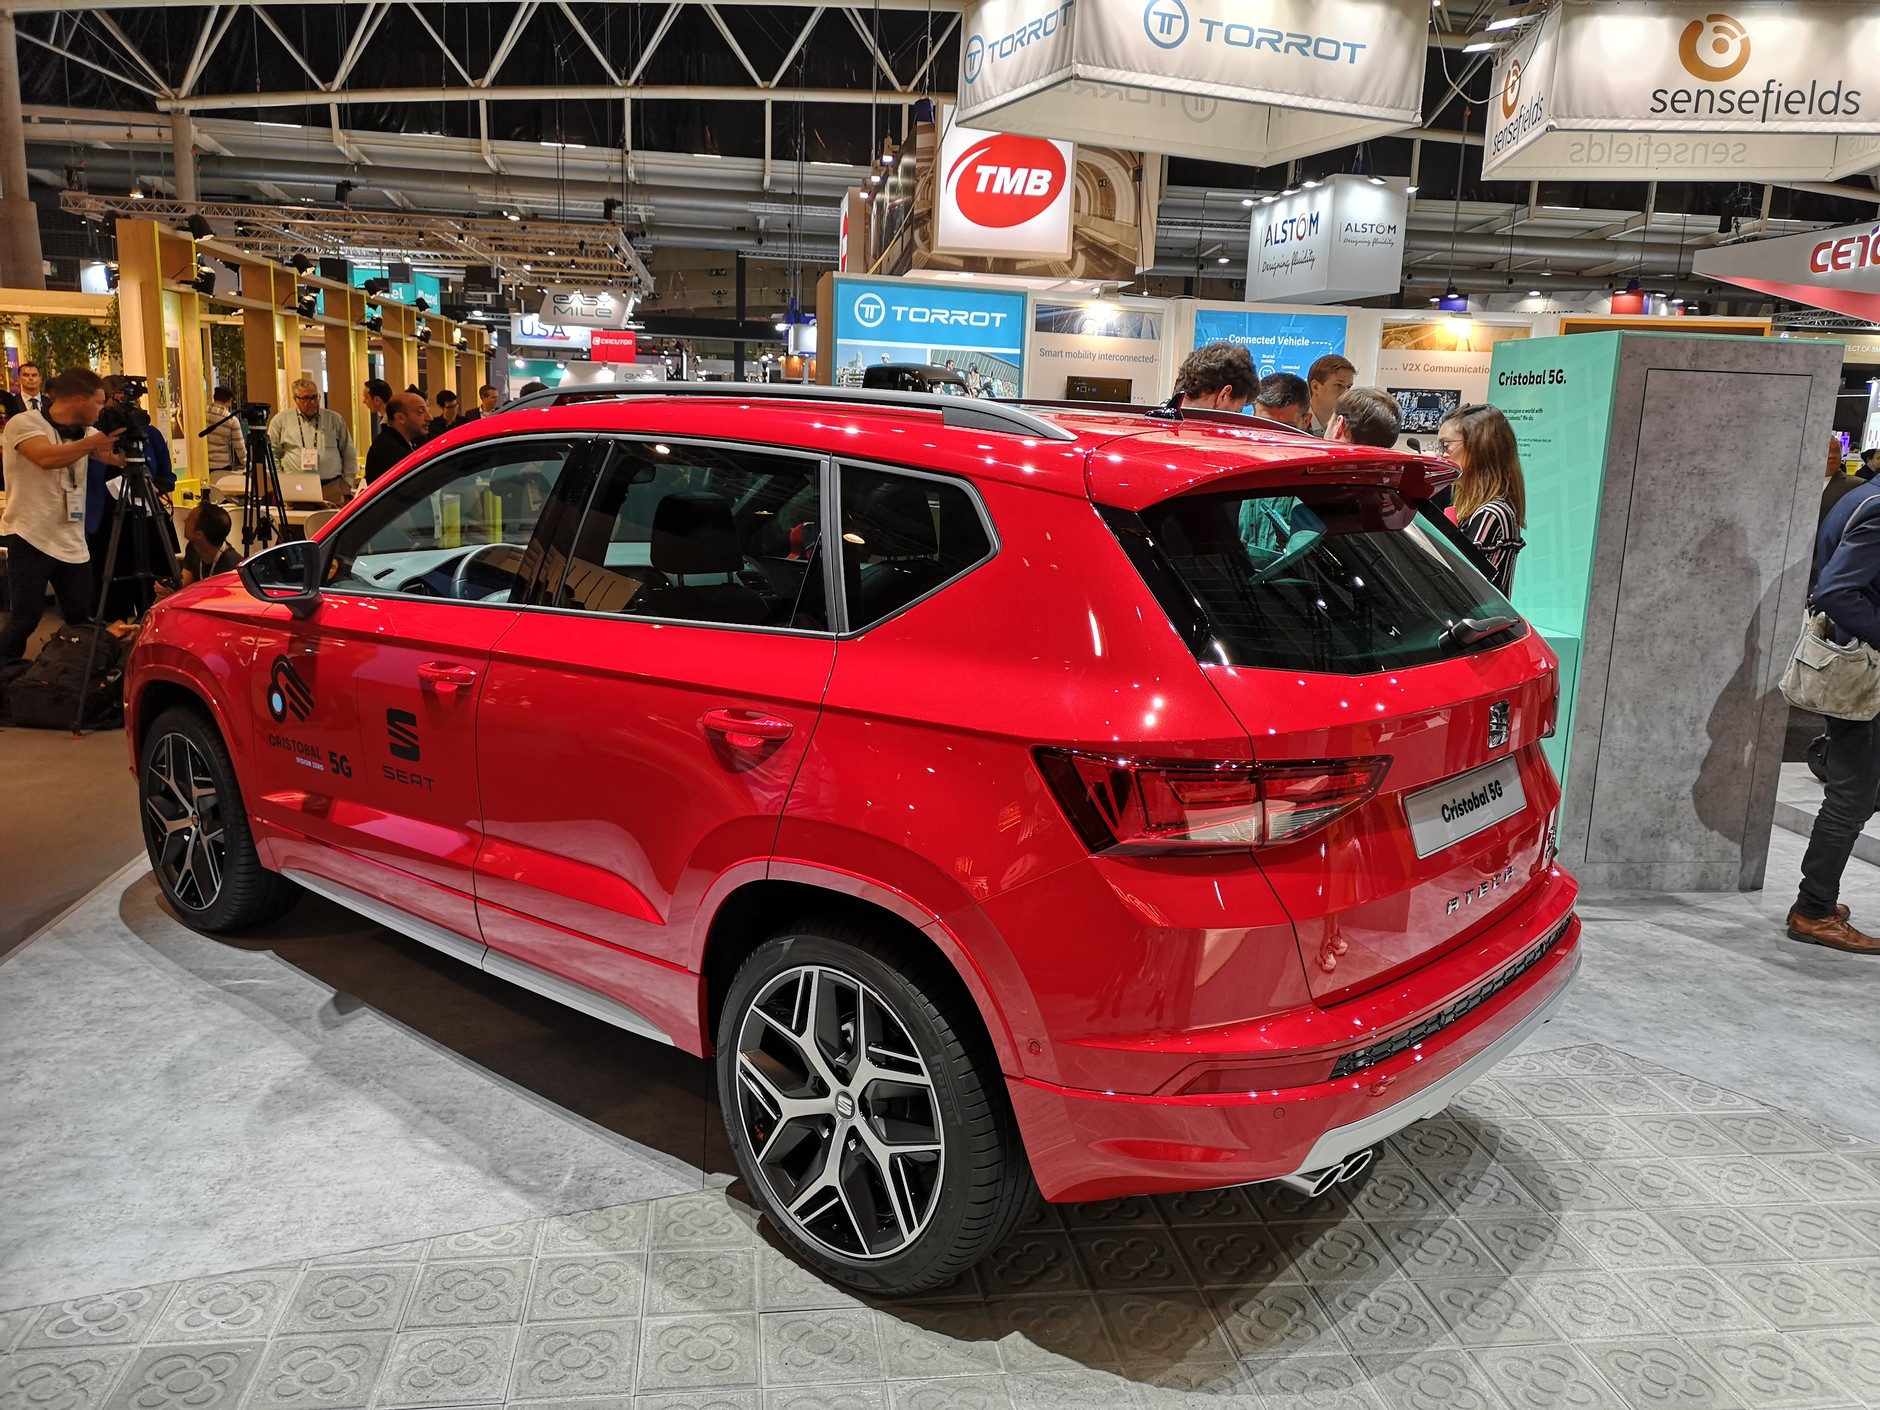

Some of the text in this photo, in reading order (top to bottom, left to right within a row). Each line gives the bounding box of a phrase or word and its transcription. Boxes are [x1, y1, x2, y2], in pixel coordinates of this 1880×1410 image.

[988, 1, 1074, 64] TORROT
[1199, 18, 1367, 64] TORROT
[1650, 79, 1862, 123] sensefields
[1492, 90, 1544, 155] sensefields
[975, 165, 1053, 196] TMB
[1264, 211, 1320, 247] ALSTOM
[1343, 237, 1372, 247] Designing
[1345, 222, 1397, 235] ALSTOM
[1262, 249, 1316, 278] Designing fluidity
[519, 319, 567, 338] USA
[891, 305, 1008, 328] TORROT
[600, 338, 633, 346] CIRCUTOR
[1229, 334, 1310, 346] Connected Vehicle
[1039, 347, 1154, 363] Smart mobility interconnected
[1402, 363, 1490, 374] V2X Communicatio
[1498, 368, 1567, 386] Cristobal 5G.
[268, 733, 323, 761] CRISTOBAL
[328, 751, 353, 779] 5G
[382, 765, 435, 792] SEAT
[1441, 779, 1504, 823] Cristobal 5G
[1446, 866, 1515, 915] ATECA
